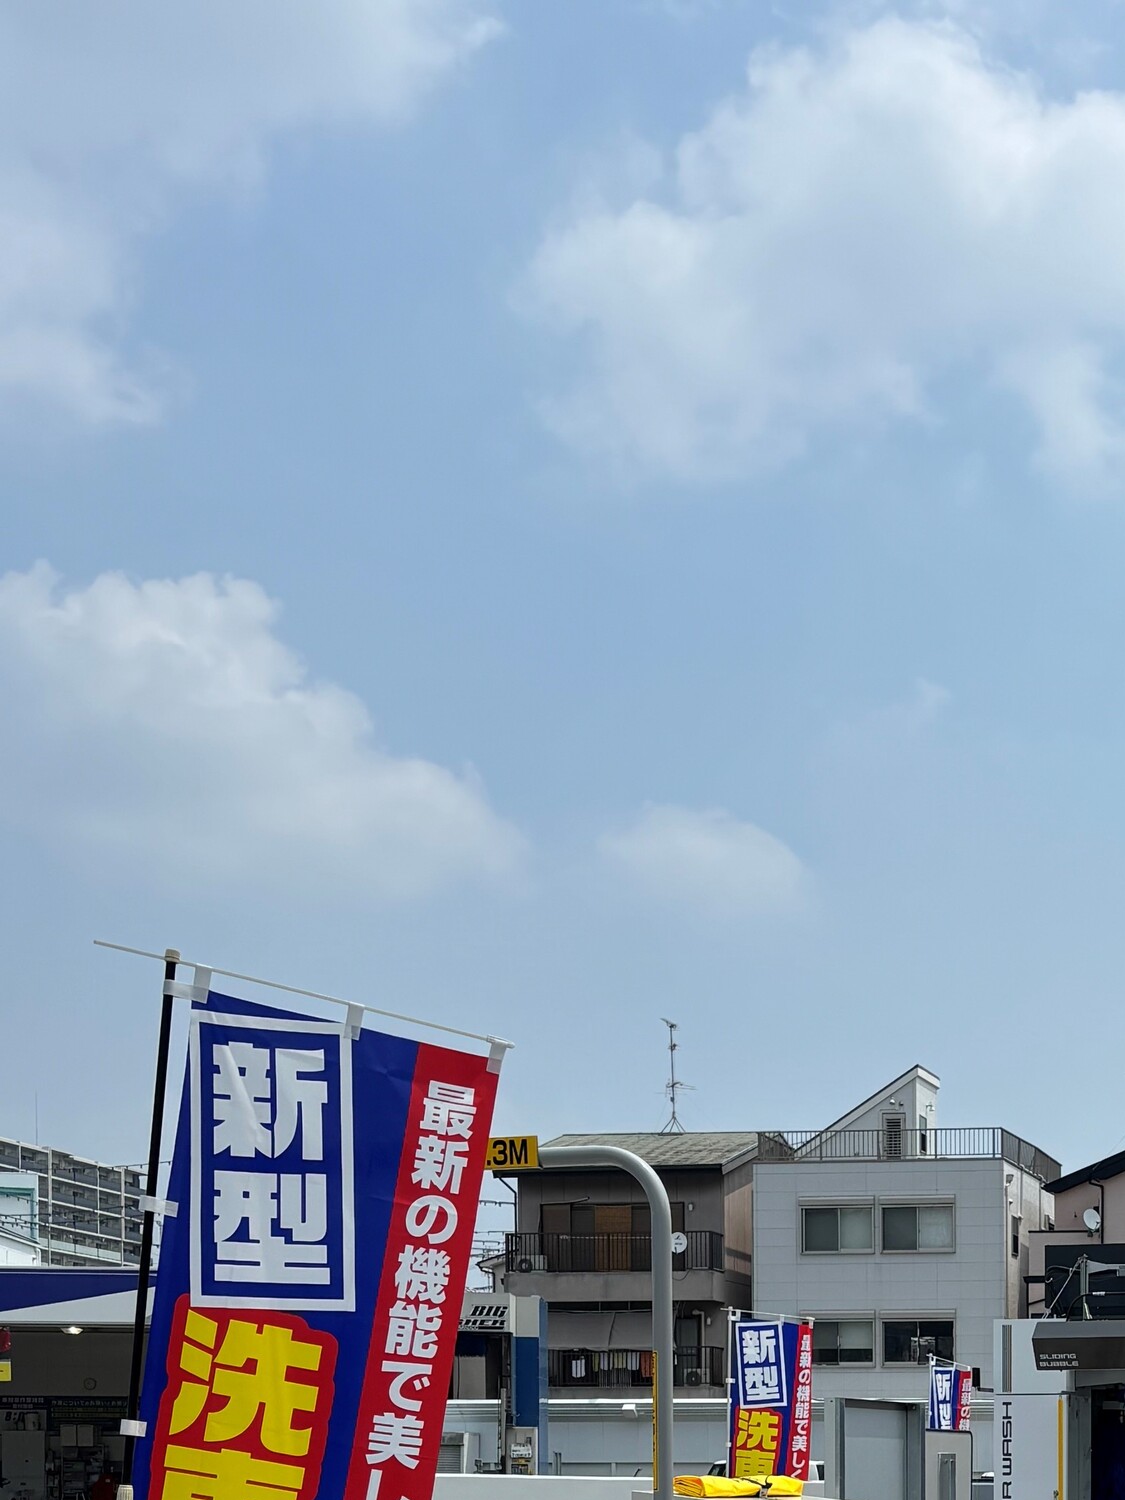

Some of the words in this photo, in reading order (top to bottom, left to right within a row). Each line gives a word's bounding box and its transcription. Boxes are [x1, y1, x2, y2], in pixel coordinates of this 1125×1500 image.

[213, 1042, 331, 1285] 新型
[470, 1306, 508, 1318] BIG
[742, 1330, 781, 1401] 新型
[735, 1409, 779, 1478] 洗車
[1002, 1401, 1012, 1476] WASH
